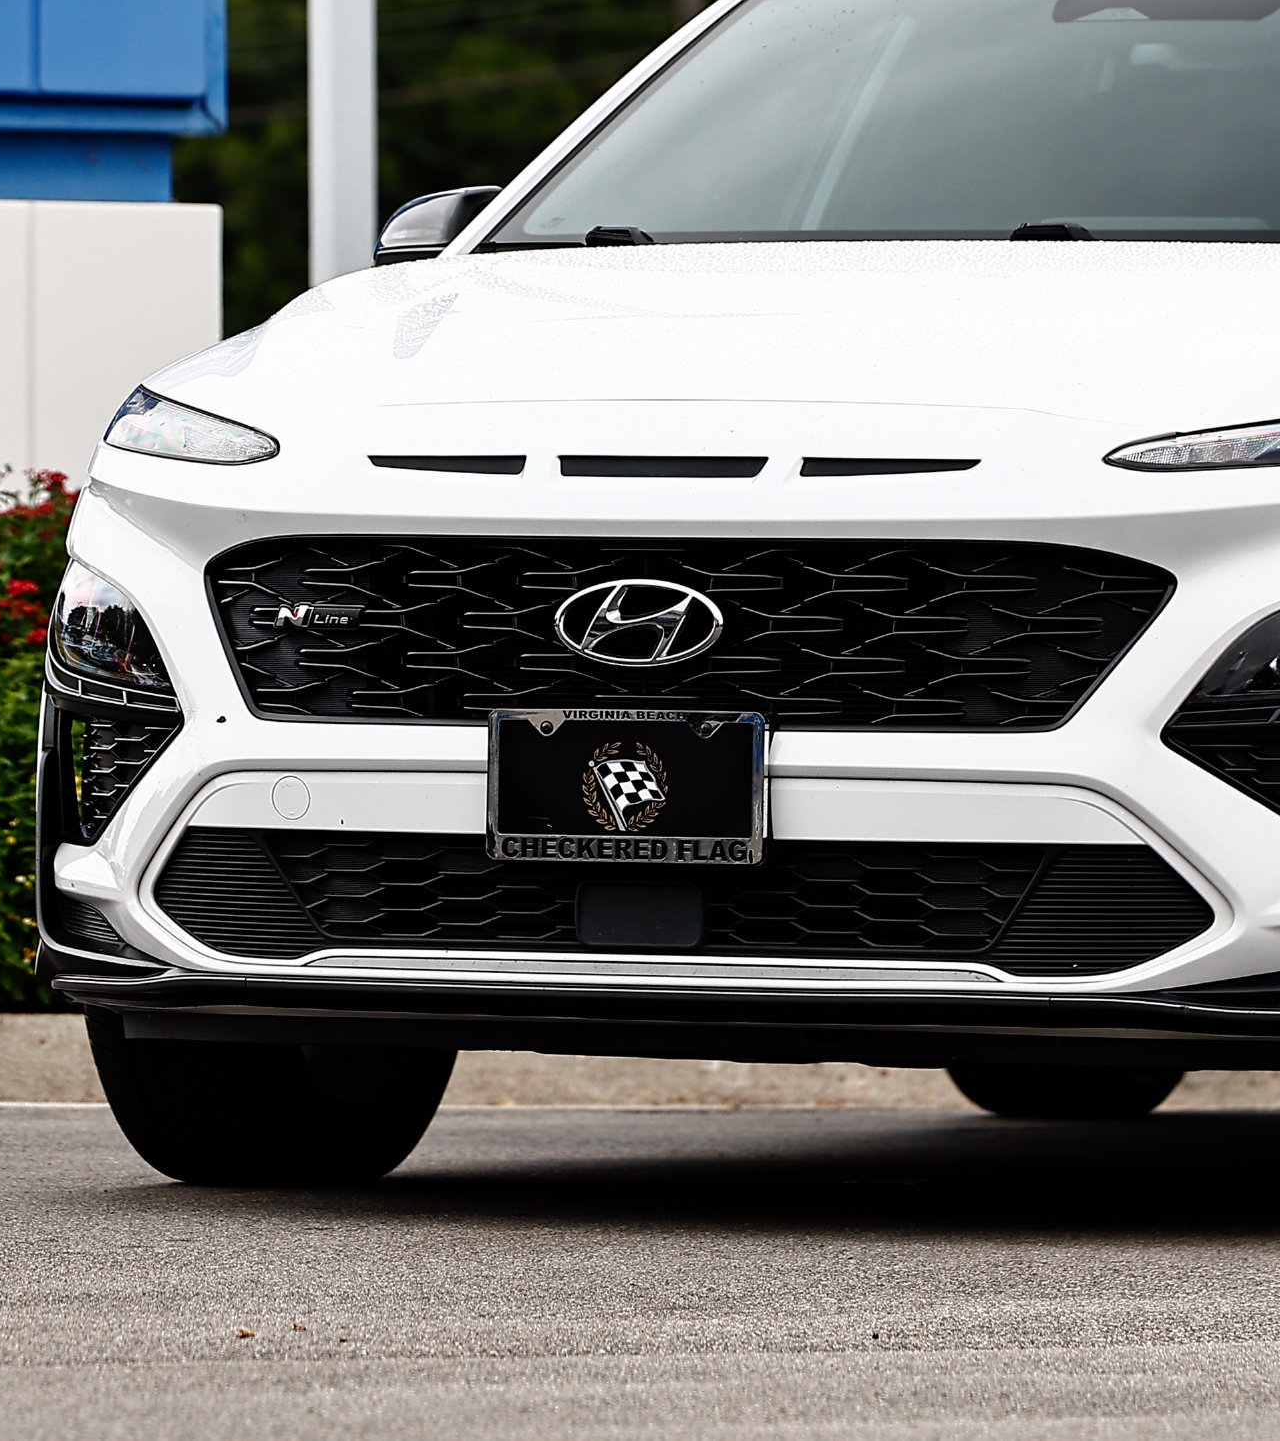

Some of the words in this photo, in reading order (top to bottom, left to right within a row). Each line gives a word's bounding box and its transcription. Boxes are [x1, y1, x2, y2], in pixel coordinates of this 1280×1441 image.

[314, 614, 349, 624] Line
[562, 710, 631, 720] VIRGINIA
[636, 710, 686, 720] BEACH
[501, 836, 668, 859] CHECKERED
[677, 840, 747, 862] FLAG
